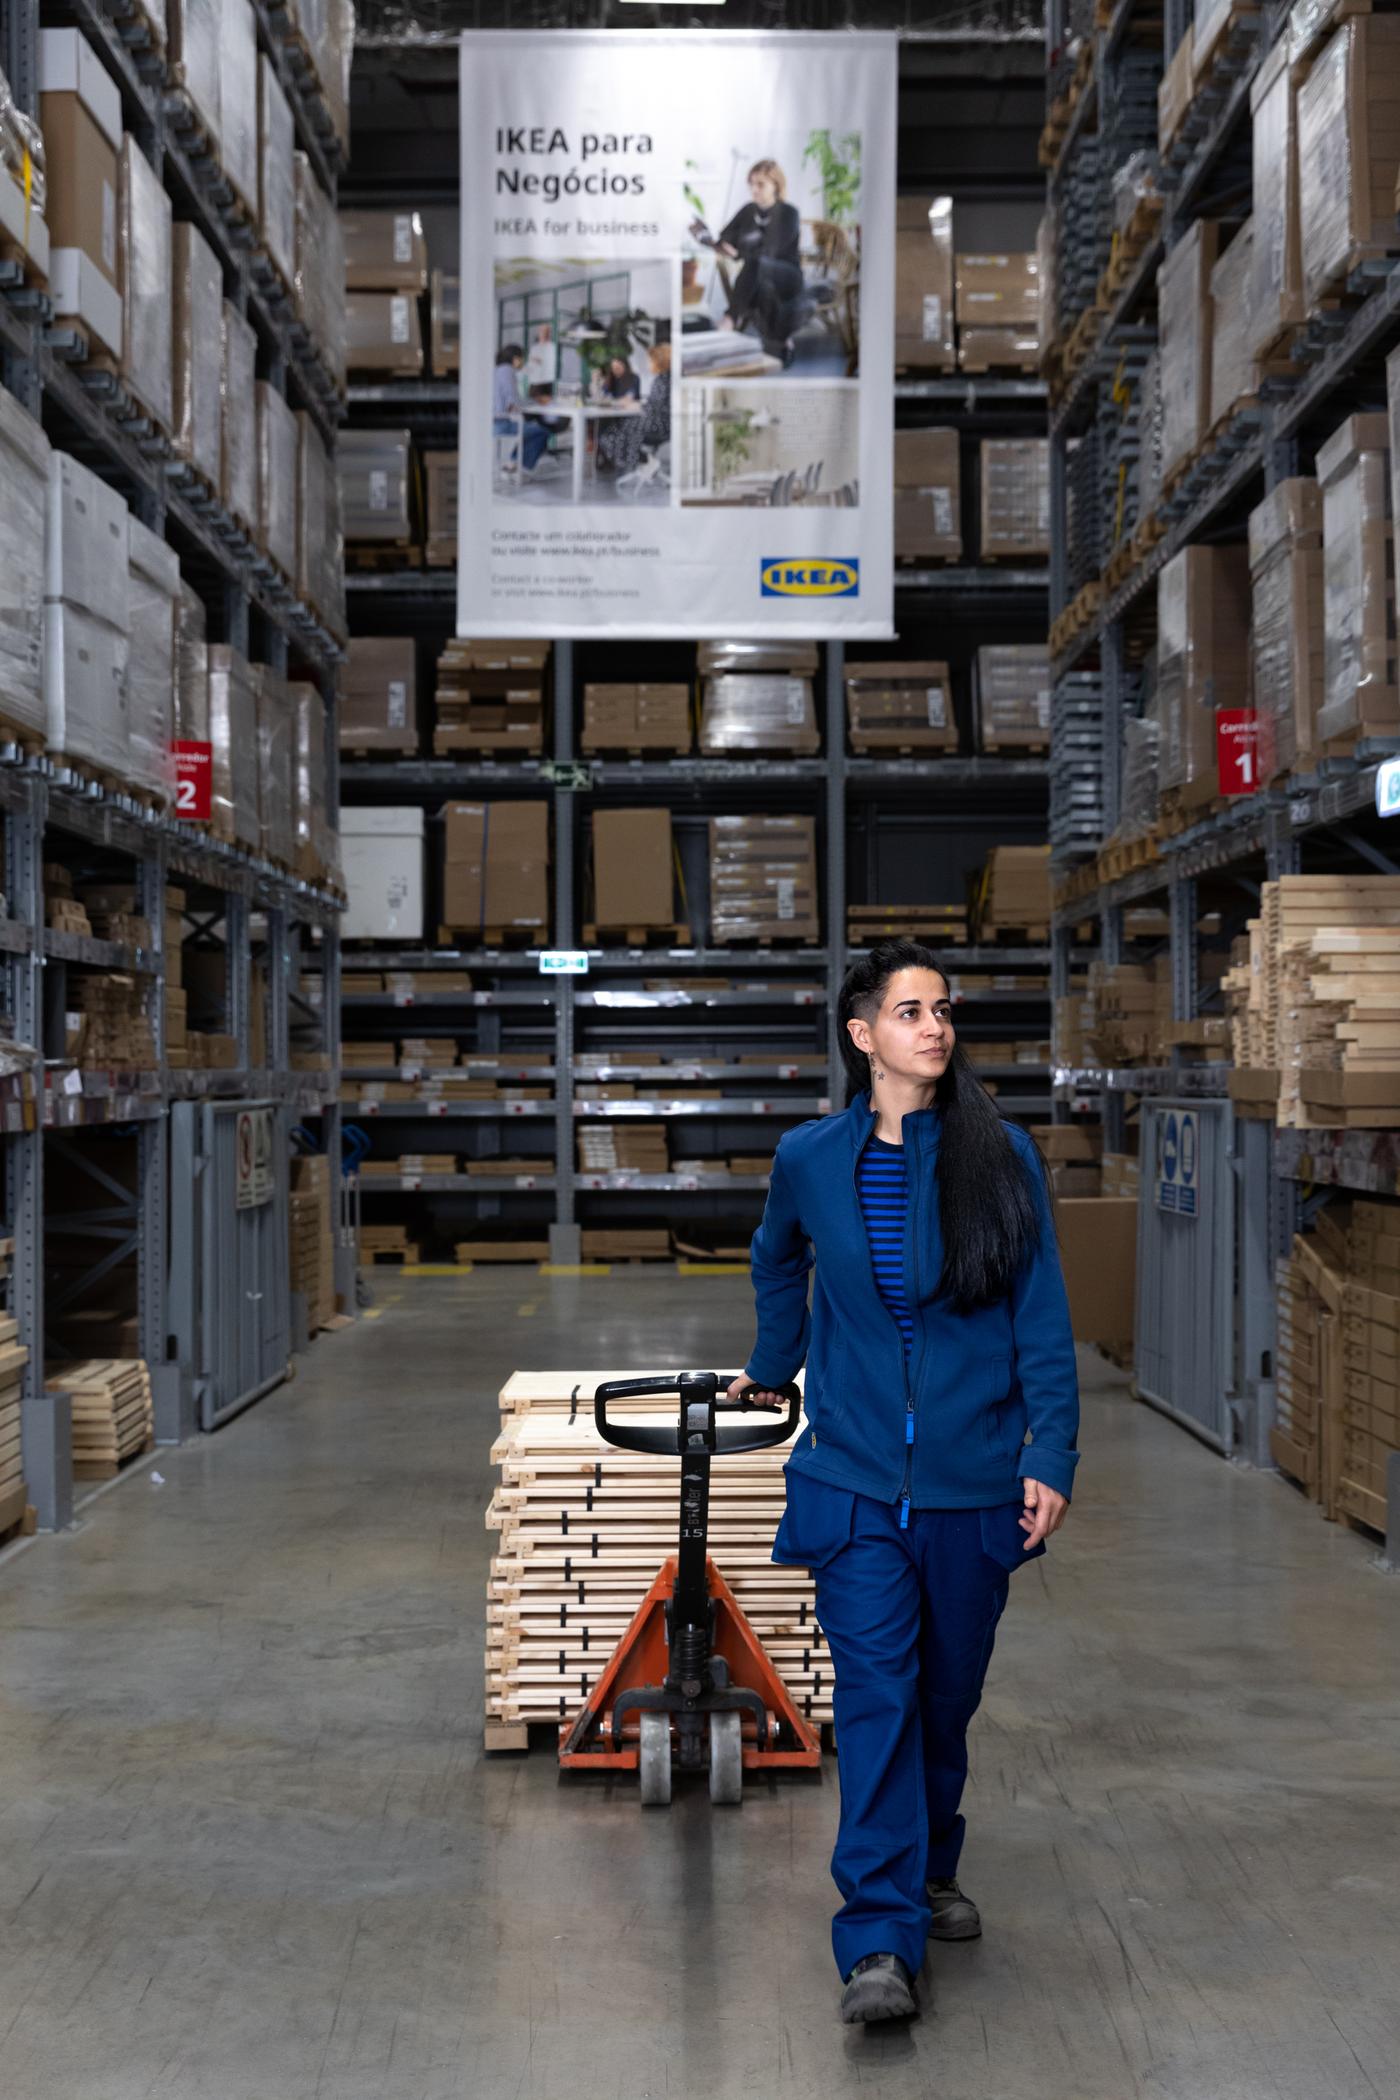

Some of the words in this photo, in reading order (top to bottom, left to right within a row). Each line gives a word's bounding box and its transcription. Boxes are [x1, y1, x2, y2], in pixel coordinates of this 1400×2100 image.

[496, 127, 569, 154] IKEA
[581, 133, 653, 162] para
[496, 166, 645, 203] Negócios
[494, 217, 537, 235] IKEA
[544, 217, 570, 235] for
[576, 217, 659, 235] business
[771, 568, 850, 585] IKEA
[1234, 752, 1252, 784] 1
[176, 780, 197, 810] 2
[1290, 803, 1311, 822] 20
[682, 1528, 703, 1538] 15
